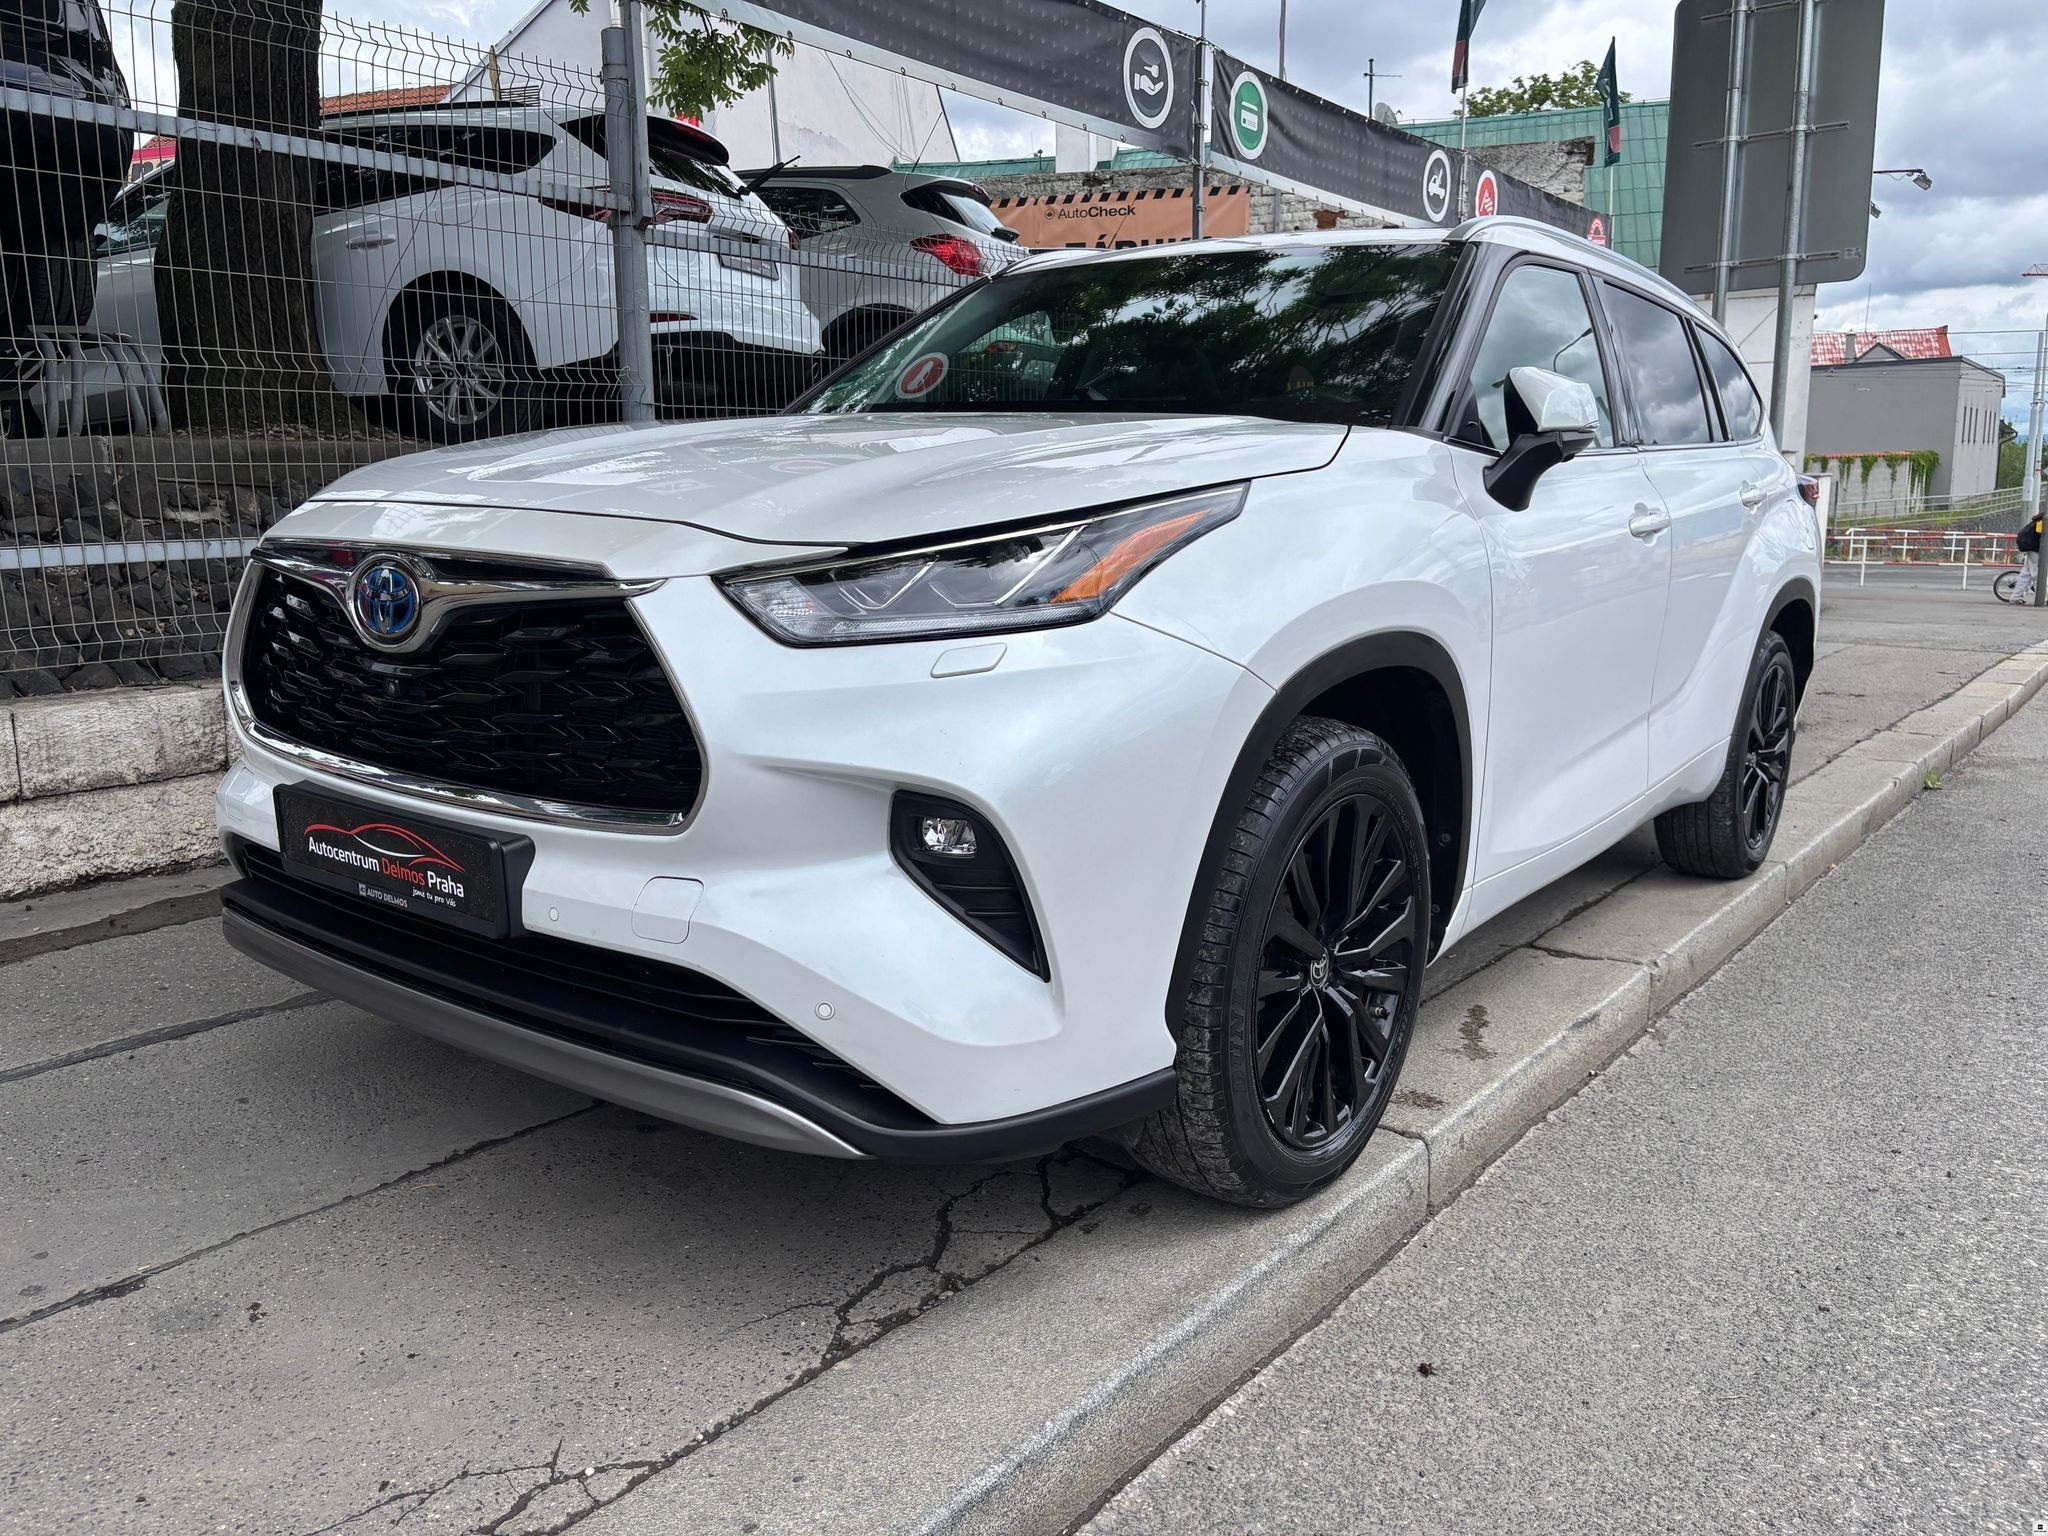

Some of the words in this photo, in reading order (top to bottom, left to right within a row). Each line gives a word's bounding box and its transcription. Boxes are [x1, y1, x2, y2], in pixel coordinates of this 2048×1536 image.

[1058, 205, 1136, 219] AutoCheck
[309, 836, 380, 872] Autocentrum
[381, 857, 425, 886] Delmos
[427, 870, 464, 898] Praha
[366, 888, 383, 899] AUTO
[383, 893, 408, 908] DELMOS
